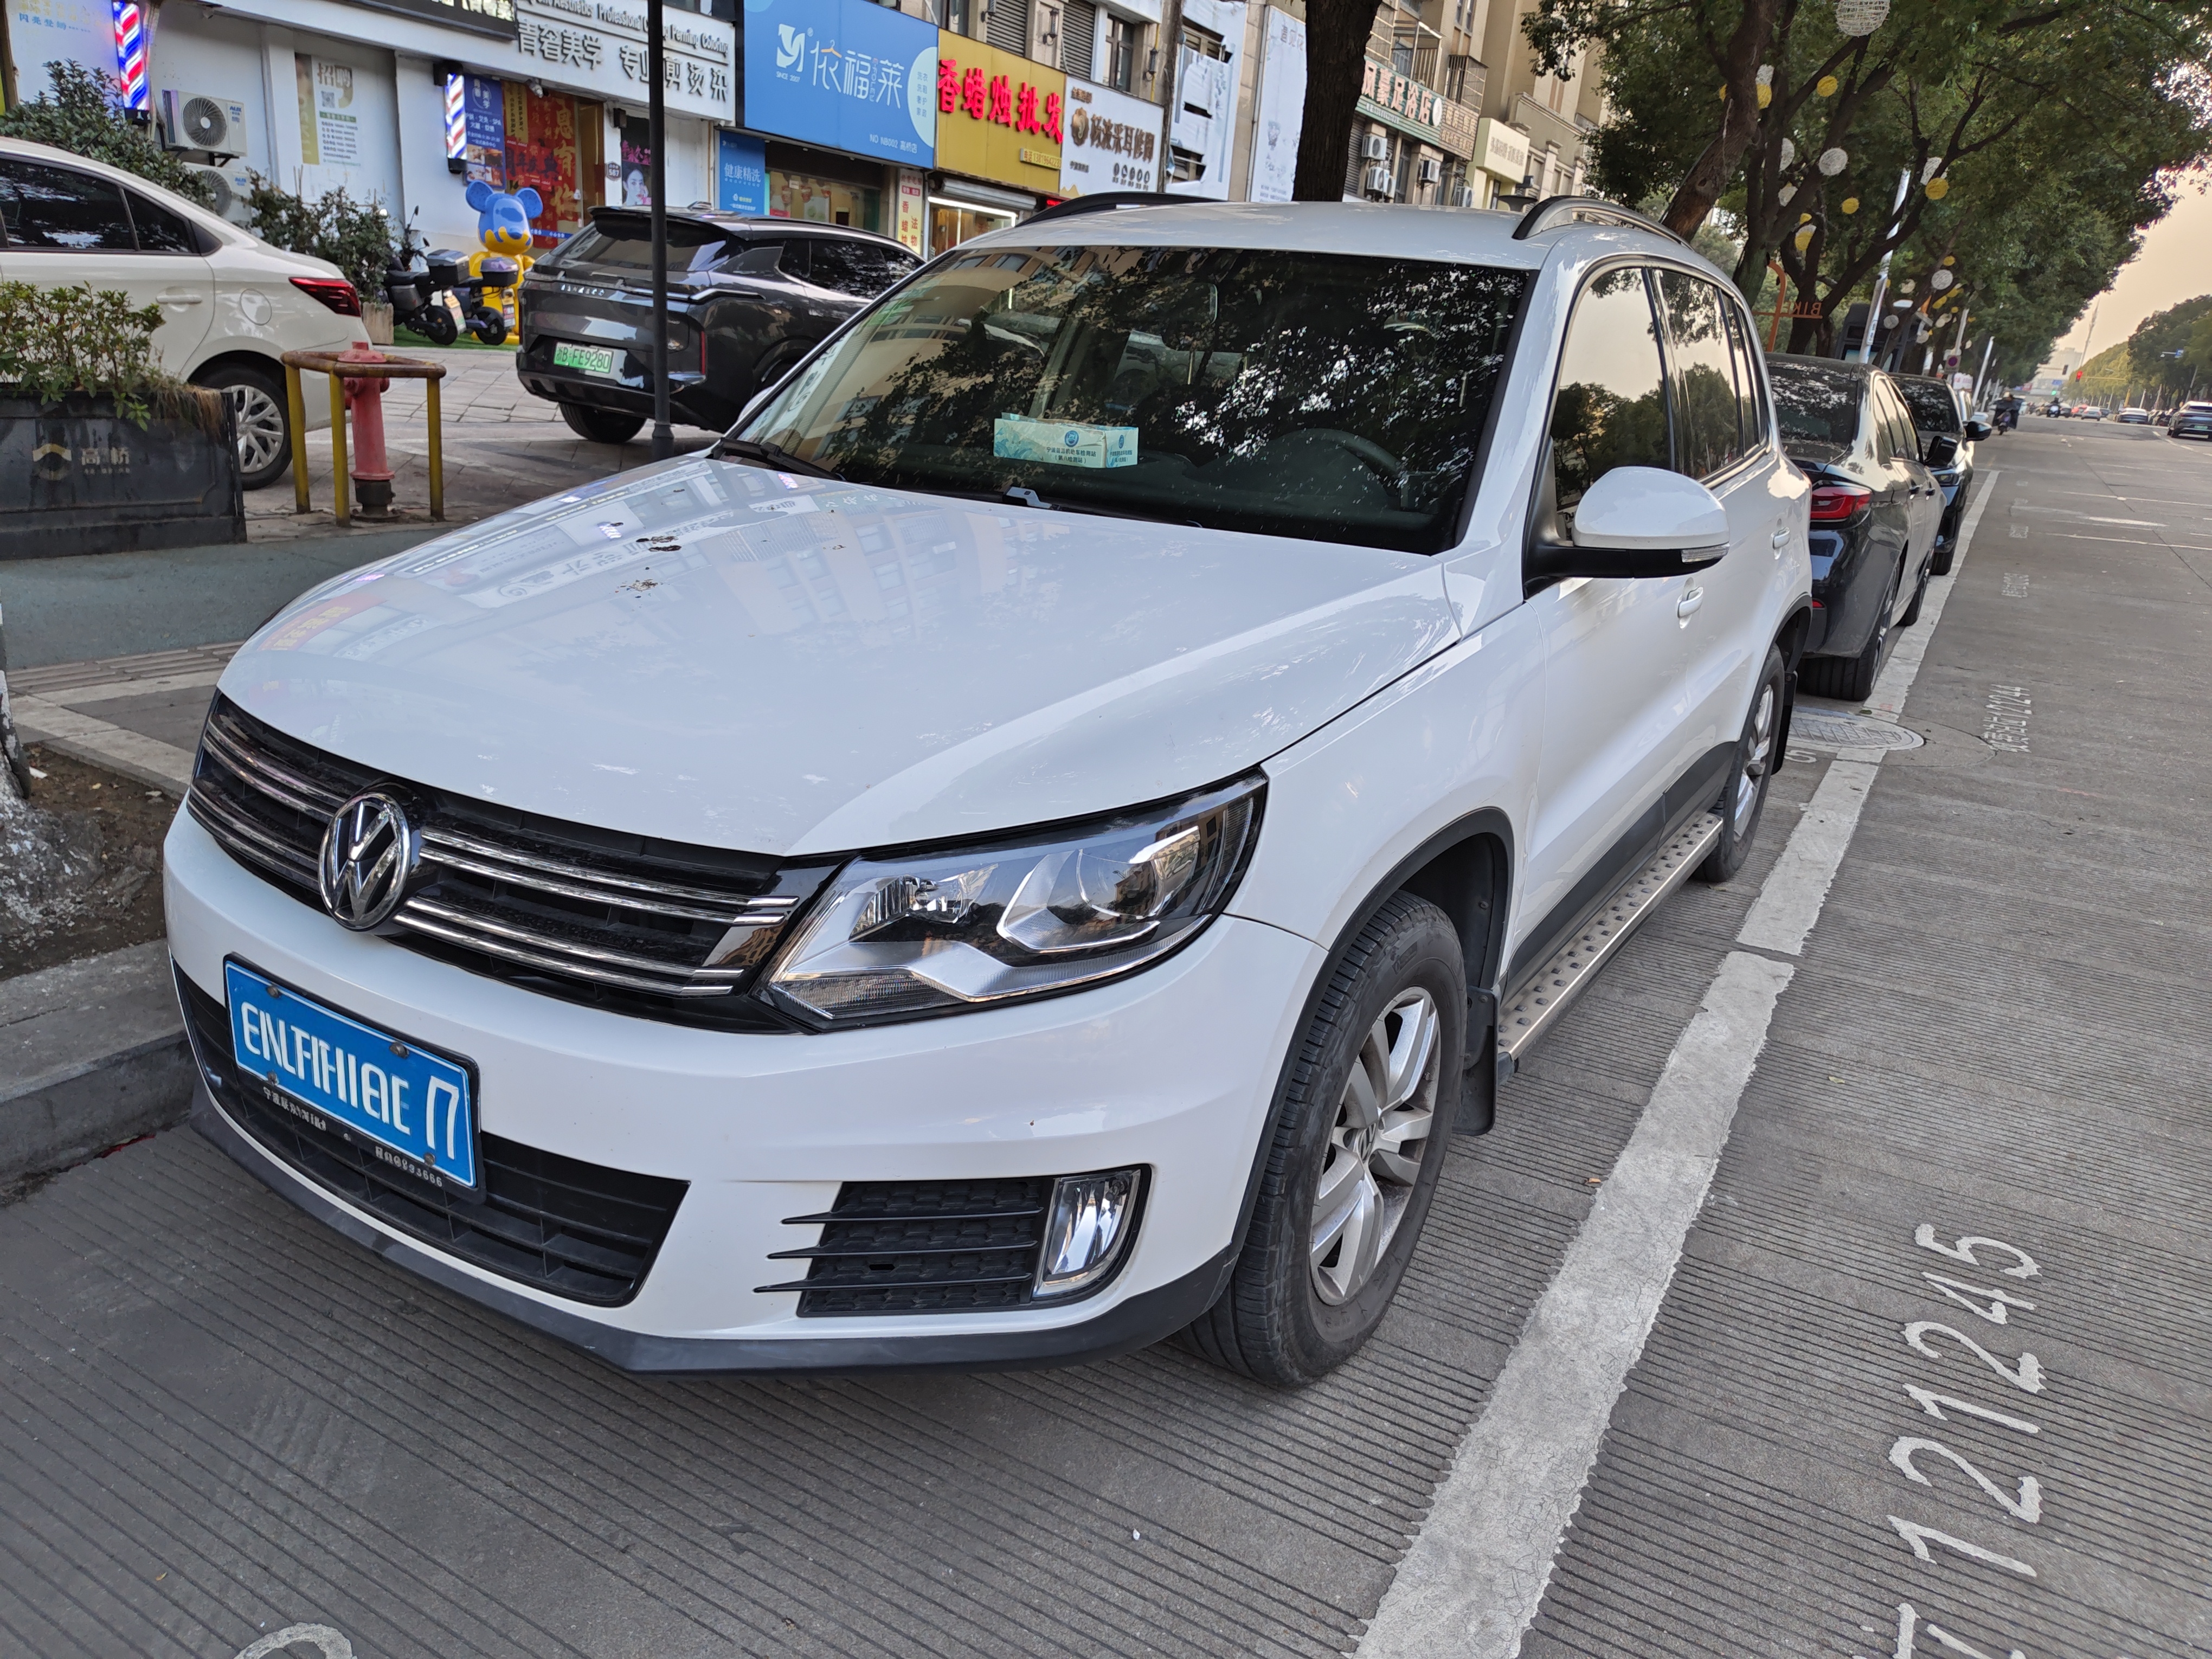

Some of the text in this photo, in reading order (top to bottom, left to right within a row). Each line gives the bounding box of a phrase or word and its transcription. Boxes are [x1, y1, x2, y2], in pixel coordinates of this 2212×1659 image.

[518, 20, 602, 70] 青奢美学
[597, 3, 642, 31] Professional
[700, 32, 729, 58] Coloring
[776, 70, 788, 80] SINCE
[938, 59, 1064, 144] 香蜡烛批发
